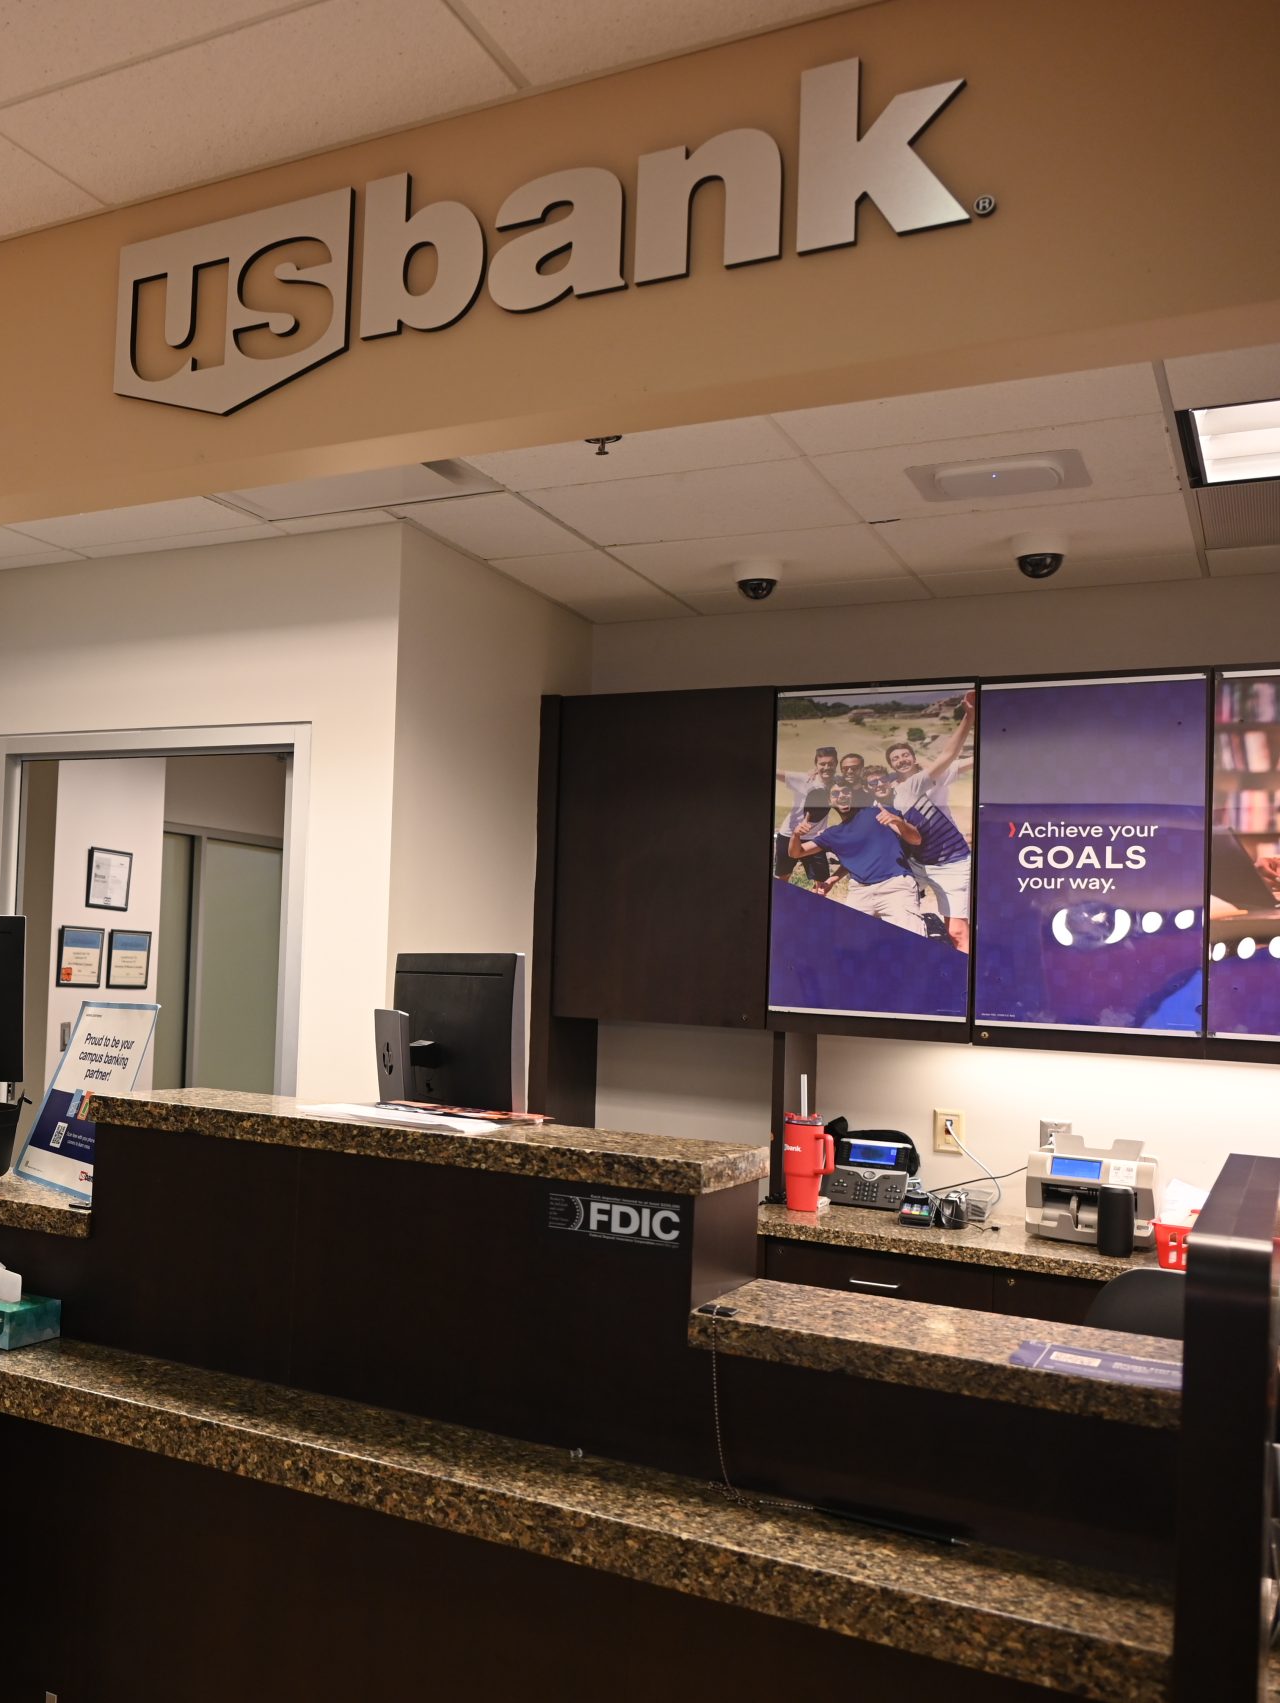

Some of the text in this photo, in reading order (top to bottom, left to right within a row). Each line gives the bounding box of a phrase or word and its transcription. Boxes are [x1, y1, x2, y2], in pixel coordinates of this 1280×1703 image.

[1018, 821, 1158, 841] Achieve your
[1018, 845, 1147, 869] GOALS
[1017, 877, 1116, 894] your way.
[84, 1032, 135, 1051] Proud to be your
[78, 1051, 129, 1070] campus banking
[83, 1068, 112, 1081] partner!
[589, 1201, 680, 1241] FDIC
